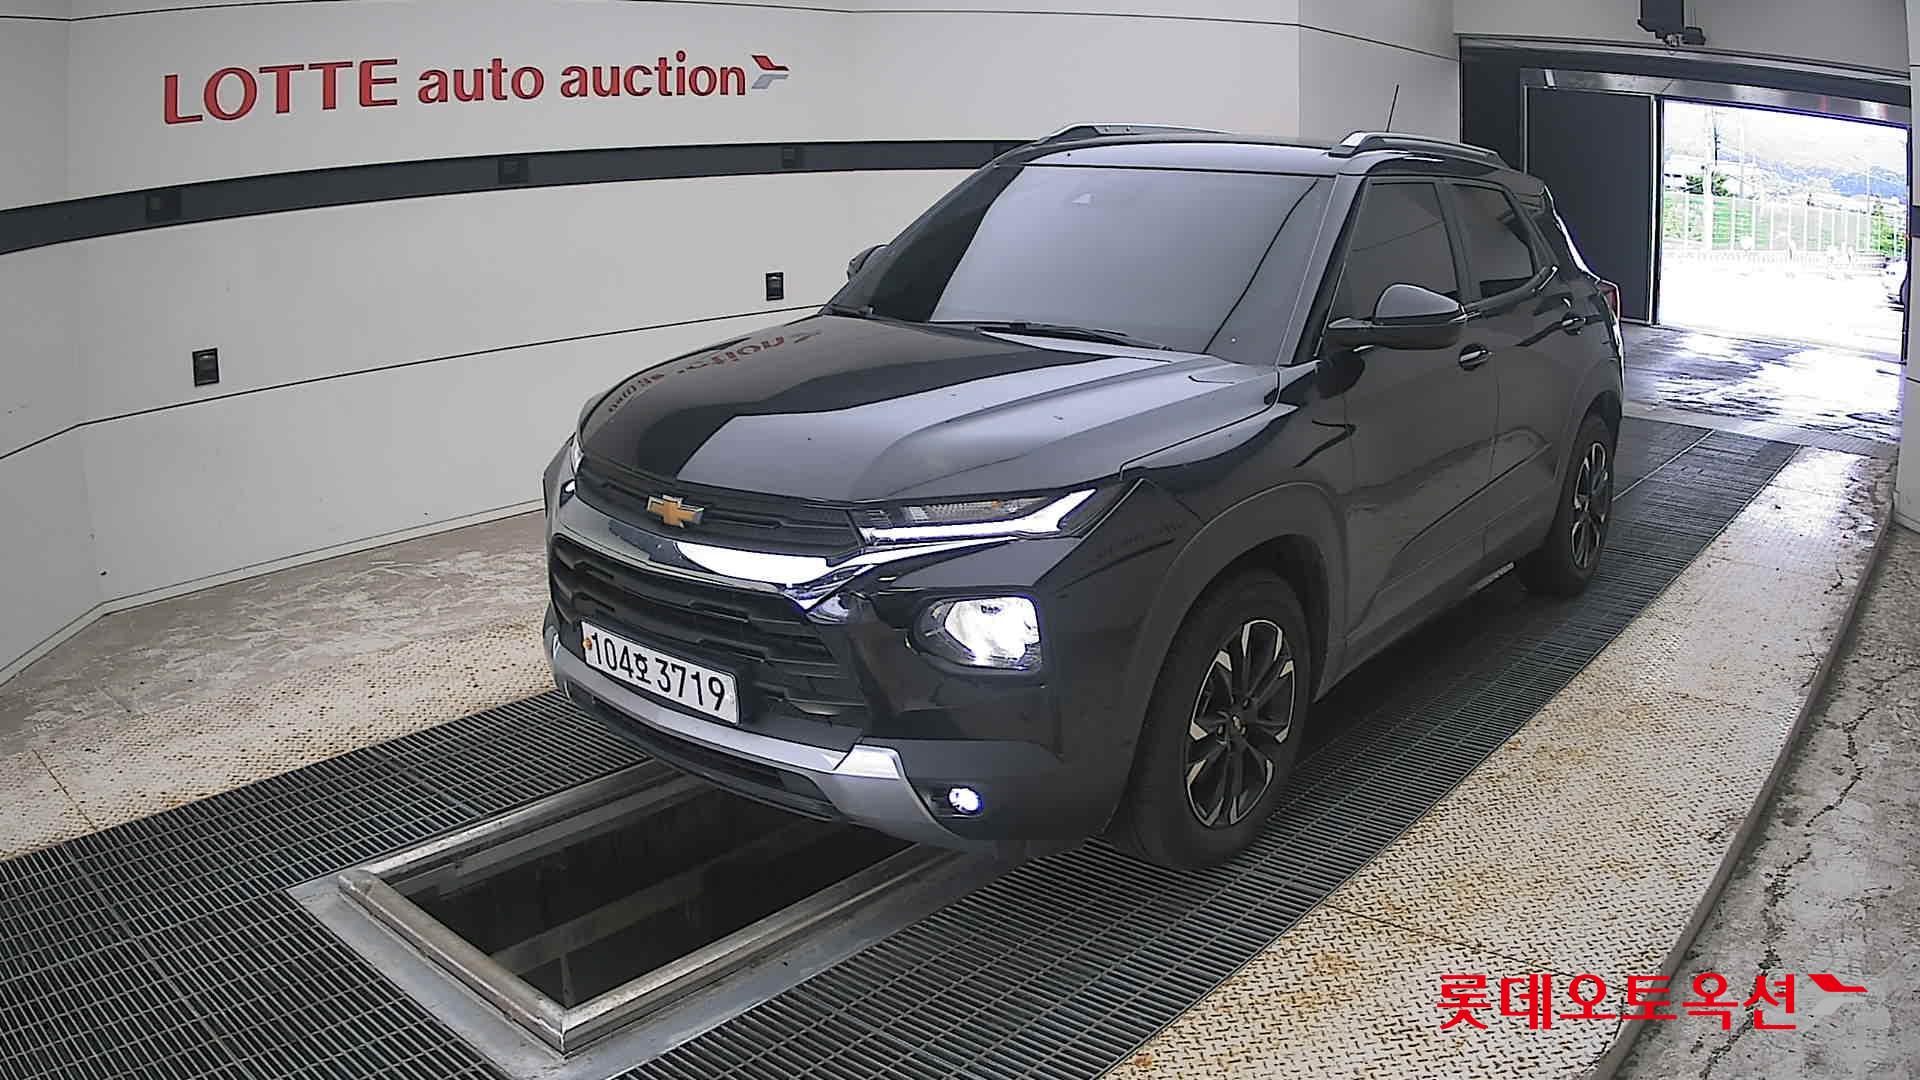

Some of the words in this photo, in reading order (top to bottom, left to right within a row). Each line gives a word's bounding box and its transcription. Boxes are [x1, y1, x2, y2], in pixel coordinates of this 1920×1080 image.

[164, 60, 397, 124] LOTTE
[418, 58, 544, 103] auto
[561, 52, 746, 97] auction
[656, 658, 725, 711] 3719
